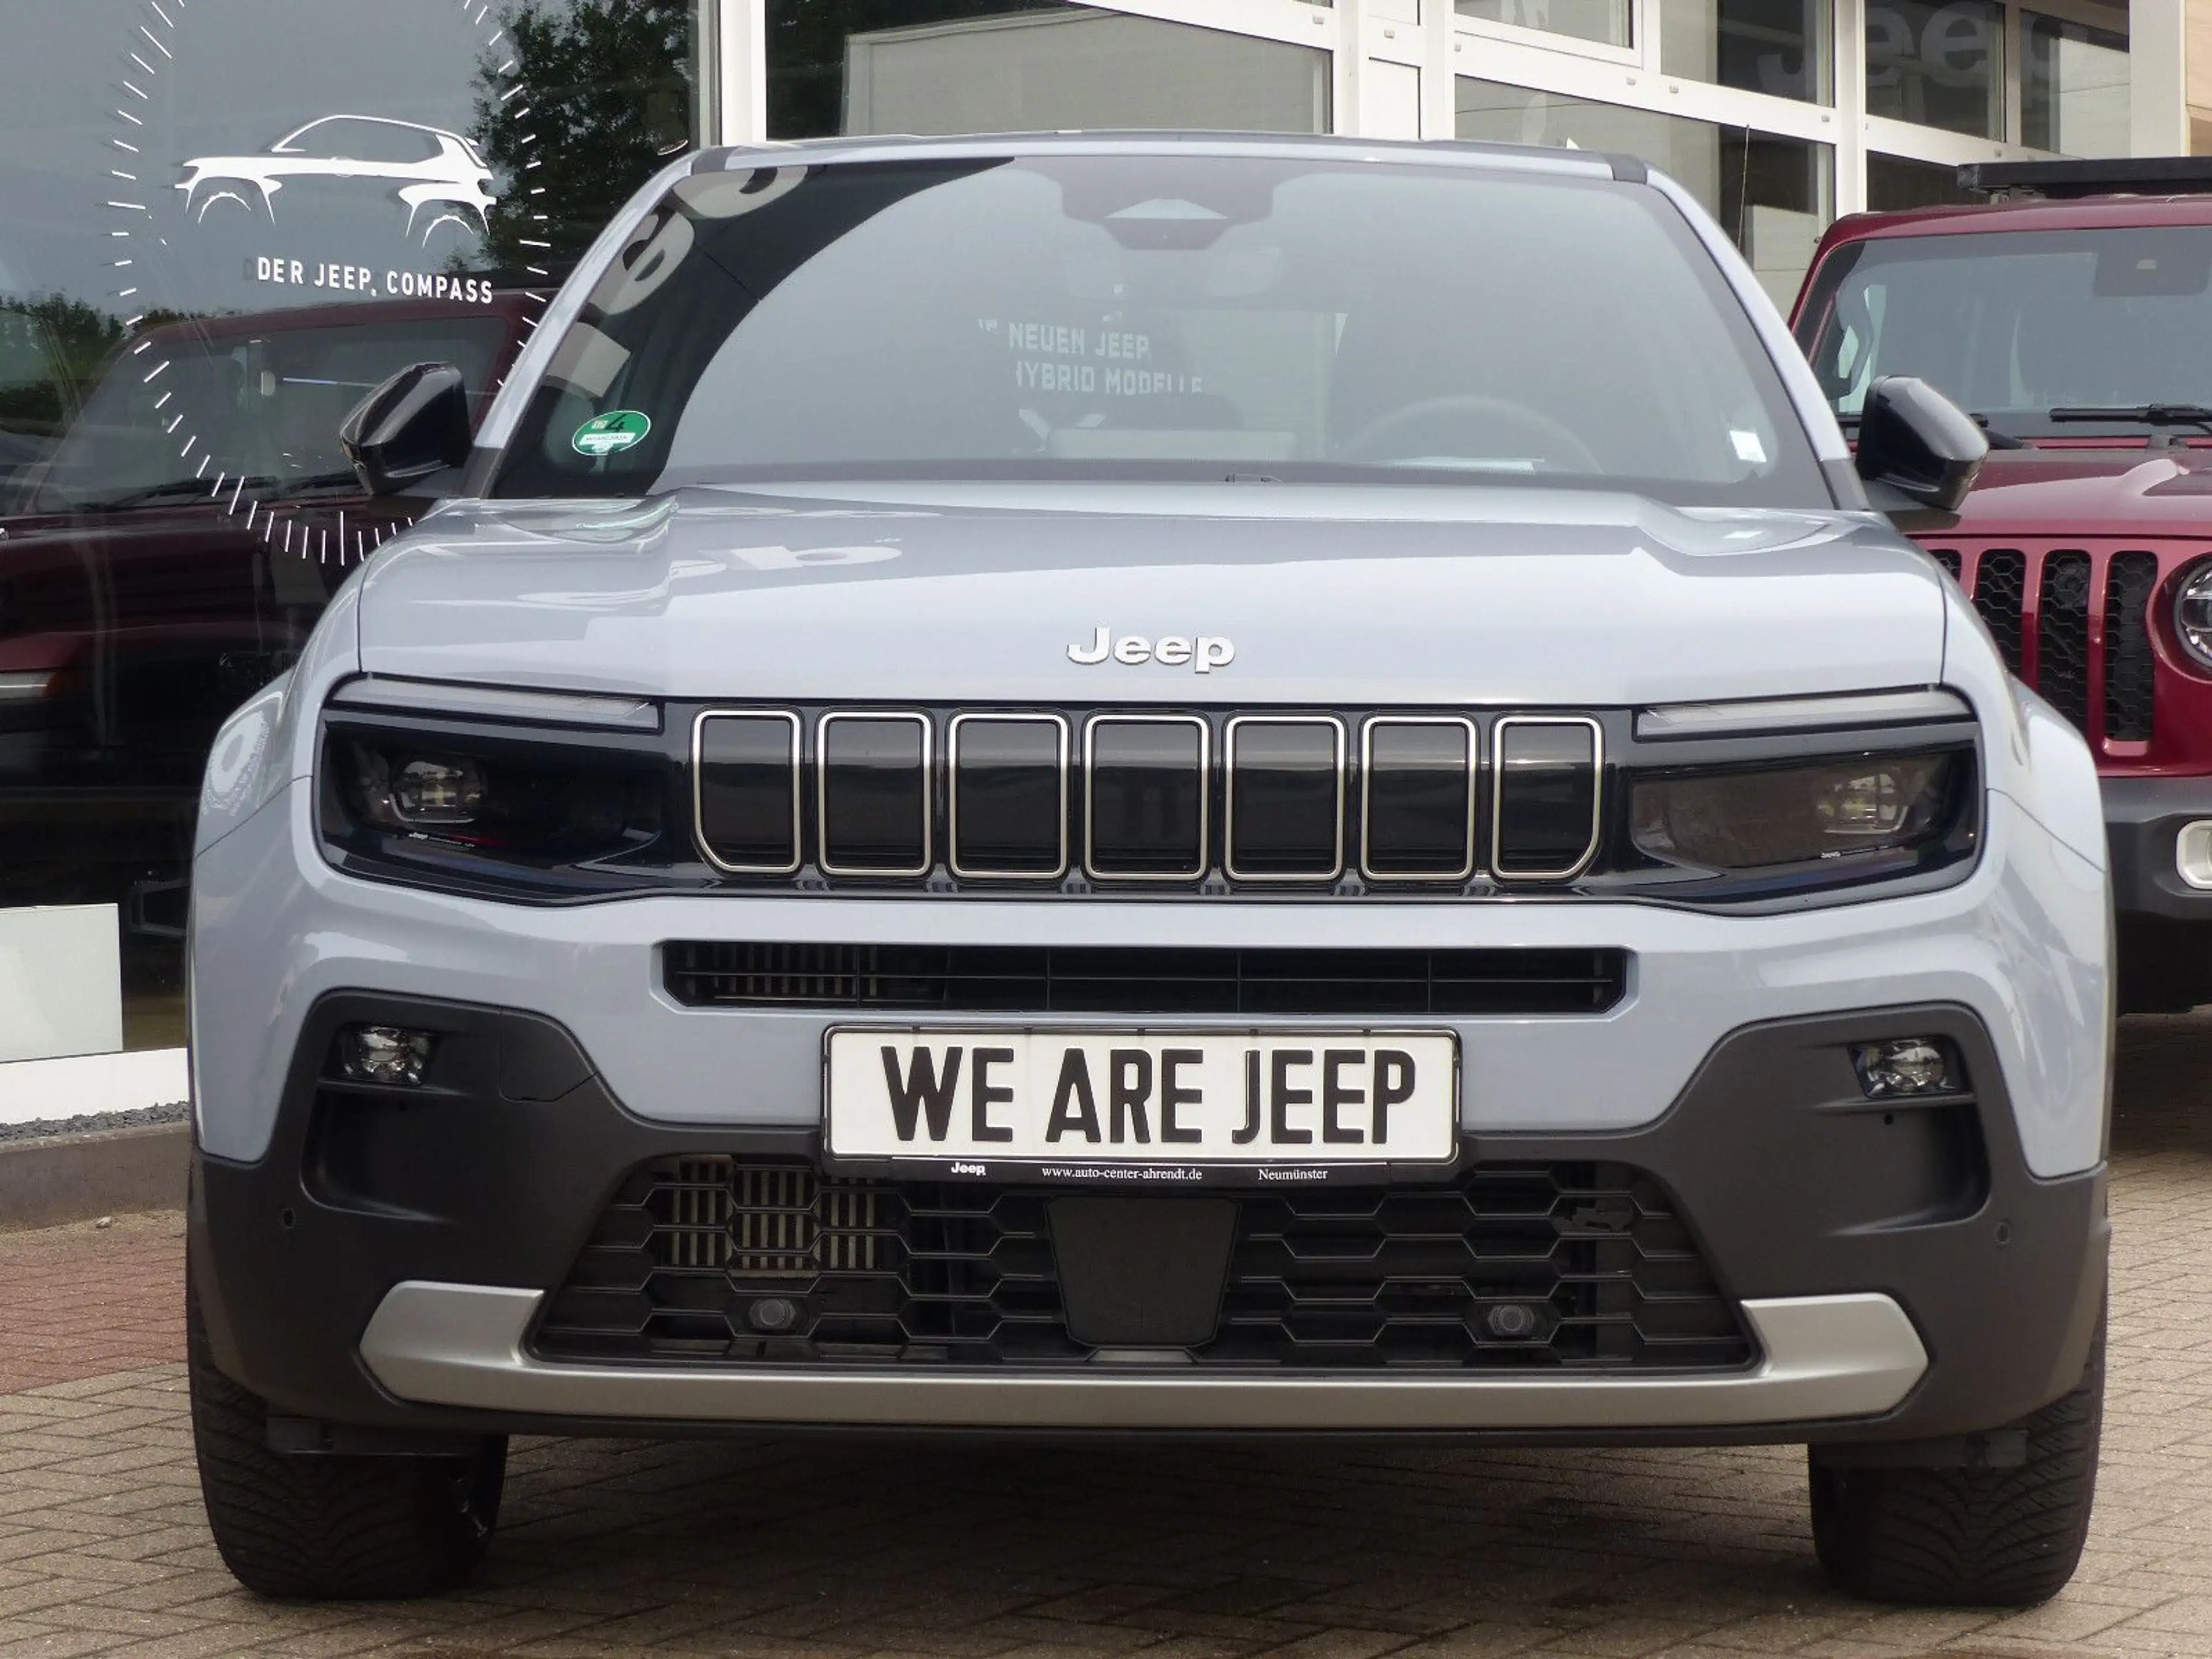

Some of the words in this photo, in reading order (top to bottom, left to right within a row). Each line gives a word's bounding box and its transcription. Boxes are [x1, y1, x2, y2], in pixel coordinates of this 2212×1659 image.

[257, 257, 304, 284] DER
[386, 270, 493, 304] COMPASS
[1008, 323, 1085, 355] NEUEN
[1066, 627, 1235, 674] Jeep
[880, 1046, 1014, 1142] WE
[1045, 1048, 1203, 1144] ARE
[1232, 1049, 1416, 1145] JEEP
[951, 1162, 985, 1176] Jeep
[1042, 1166, 1203, 1180] www.auto-center-ahrendt.de
[1257, 1168, 1328, 1180] Neumünster
